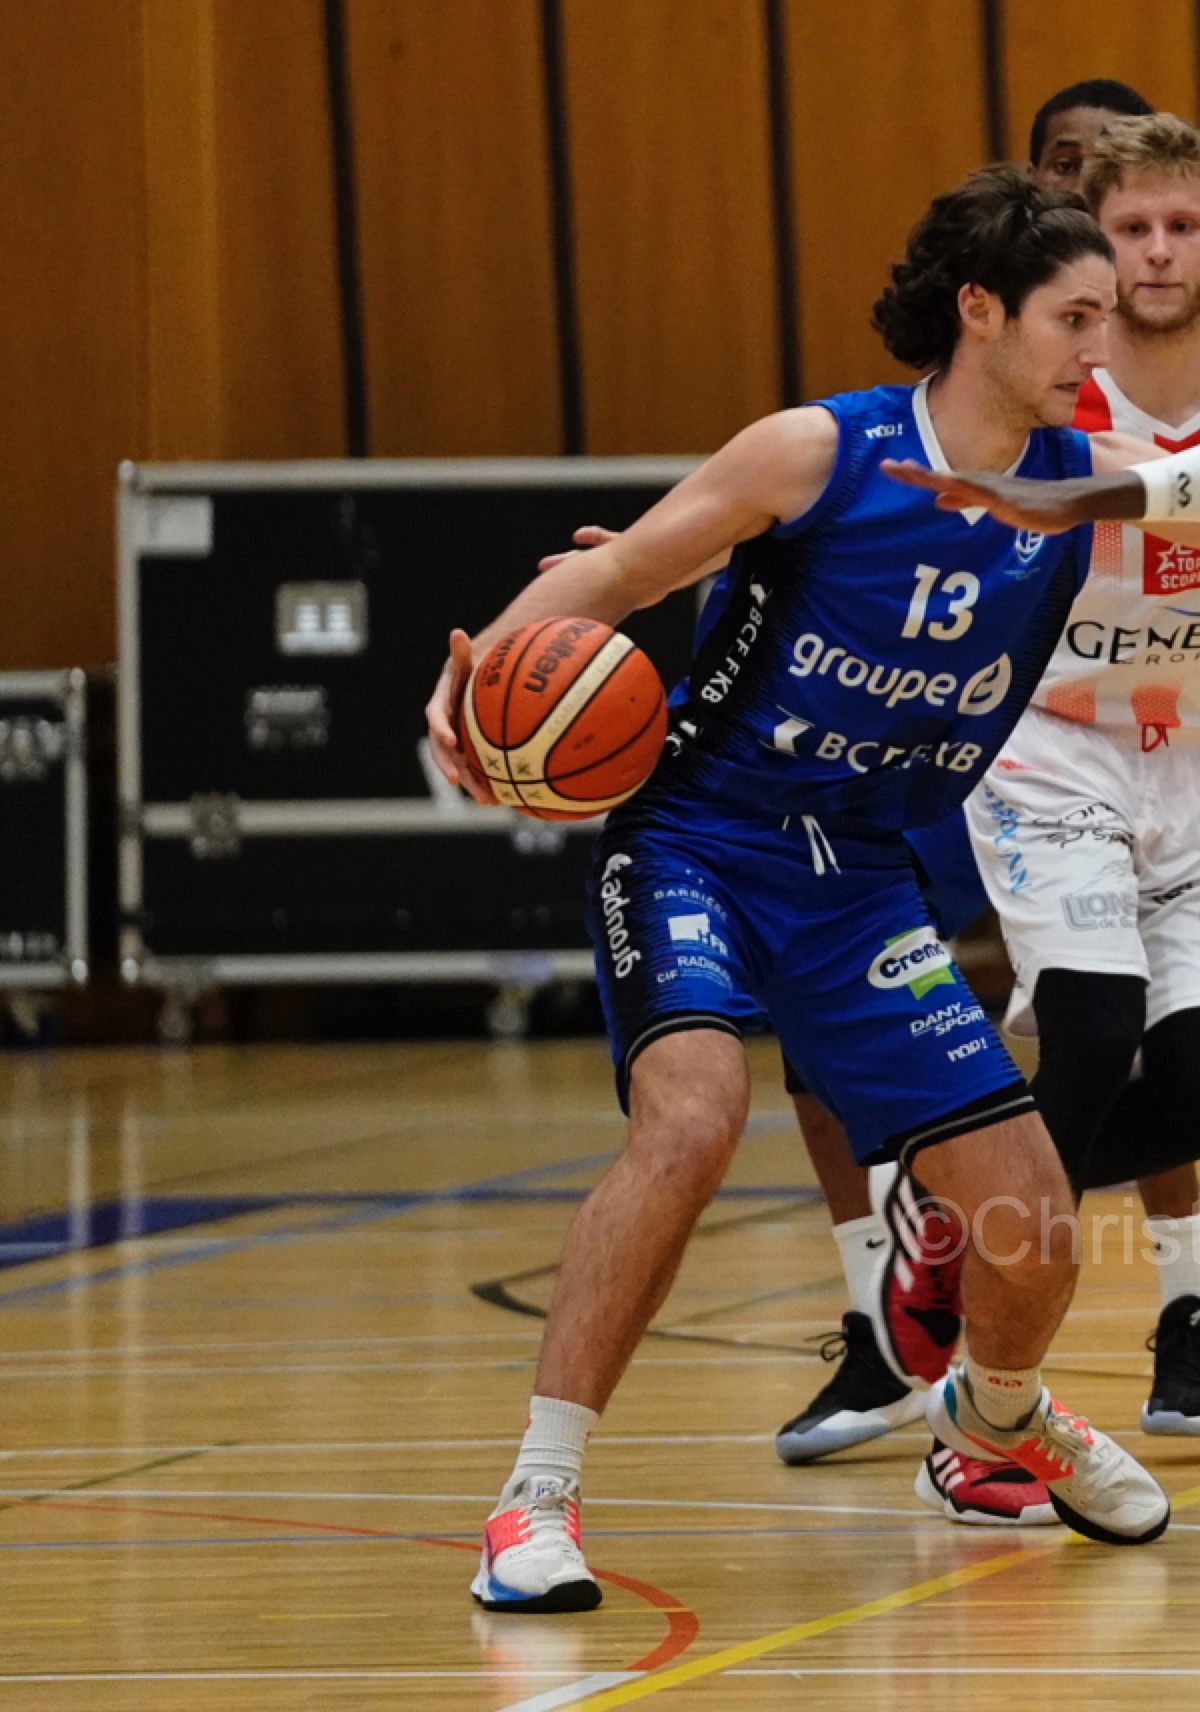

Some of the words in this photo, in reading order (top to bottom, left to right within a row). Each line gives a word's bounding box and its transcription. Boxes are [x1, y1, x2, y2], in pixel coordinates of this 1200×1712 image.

[900, 563, 981, 641] 13
[788, 632, 958, 709] groupe
[601, 877, 642, 979] groupe
[909, 1001, 961, 1034] DANY
